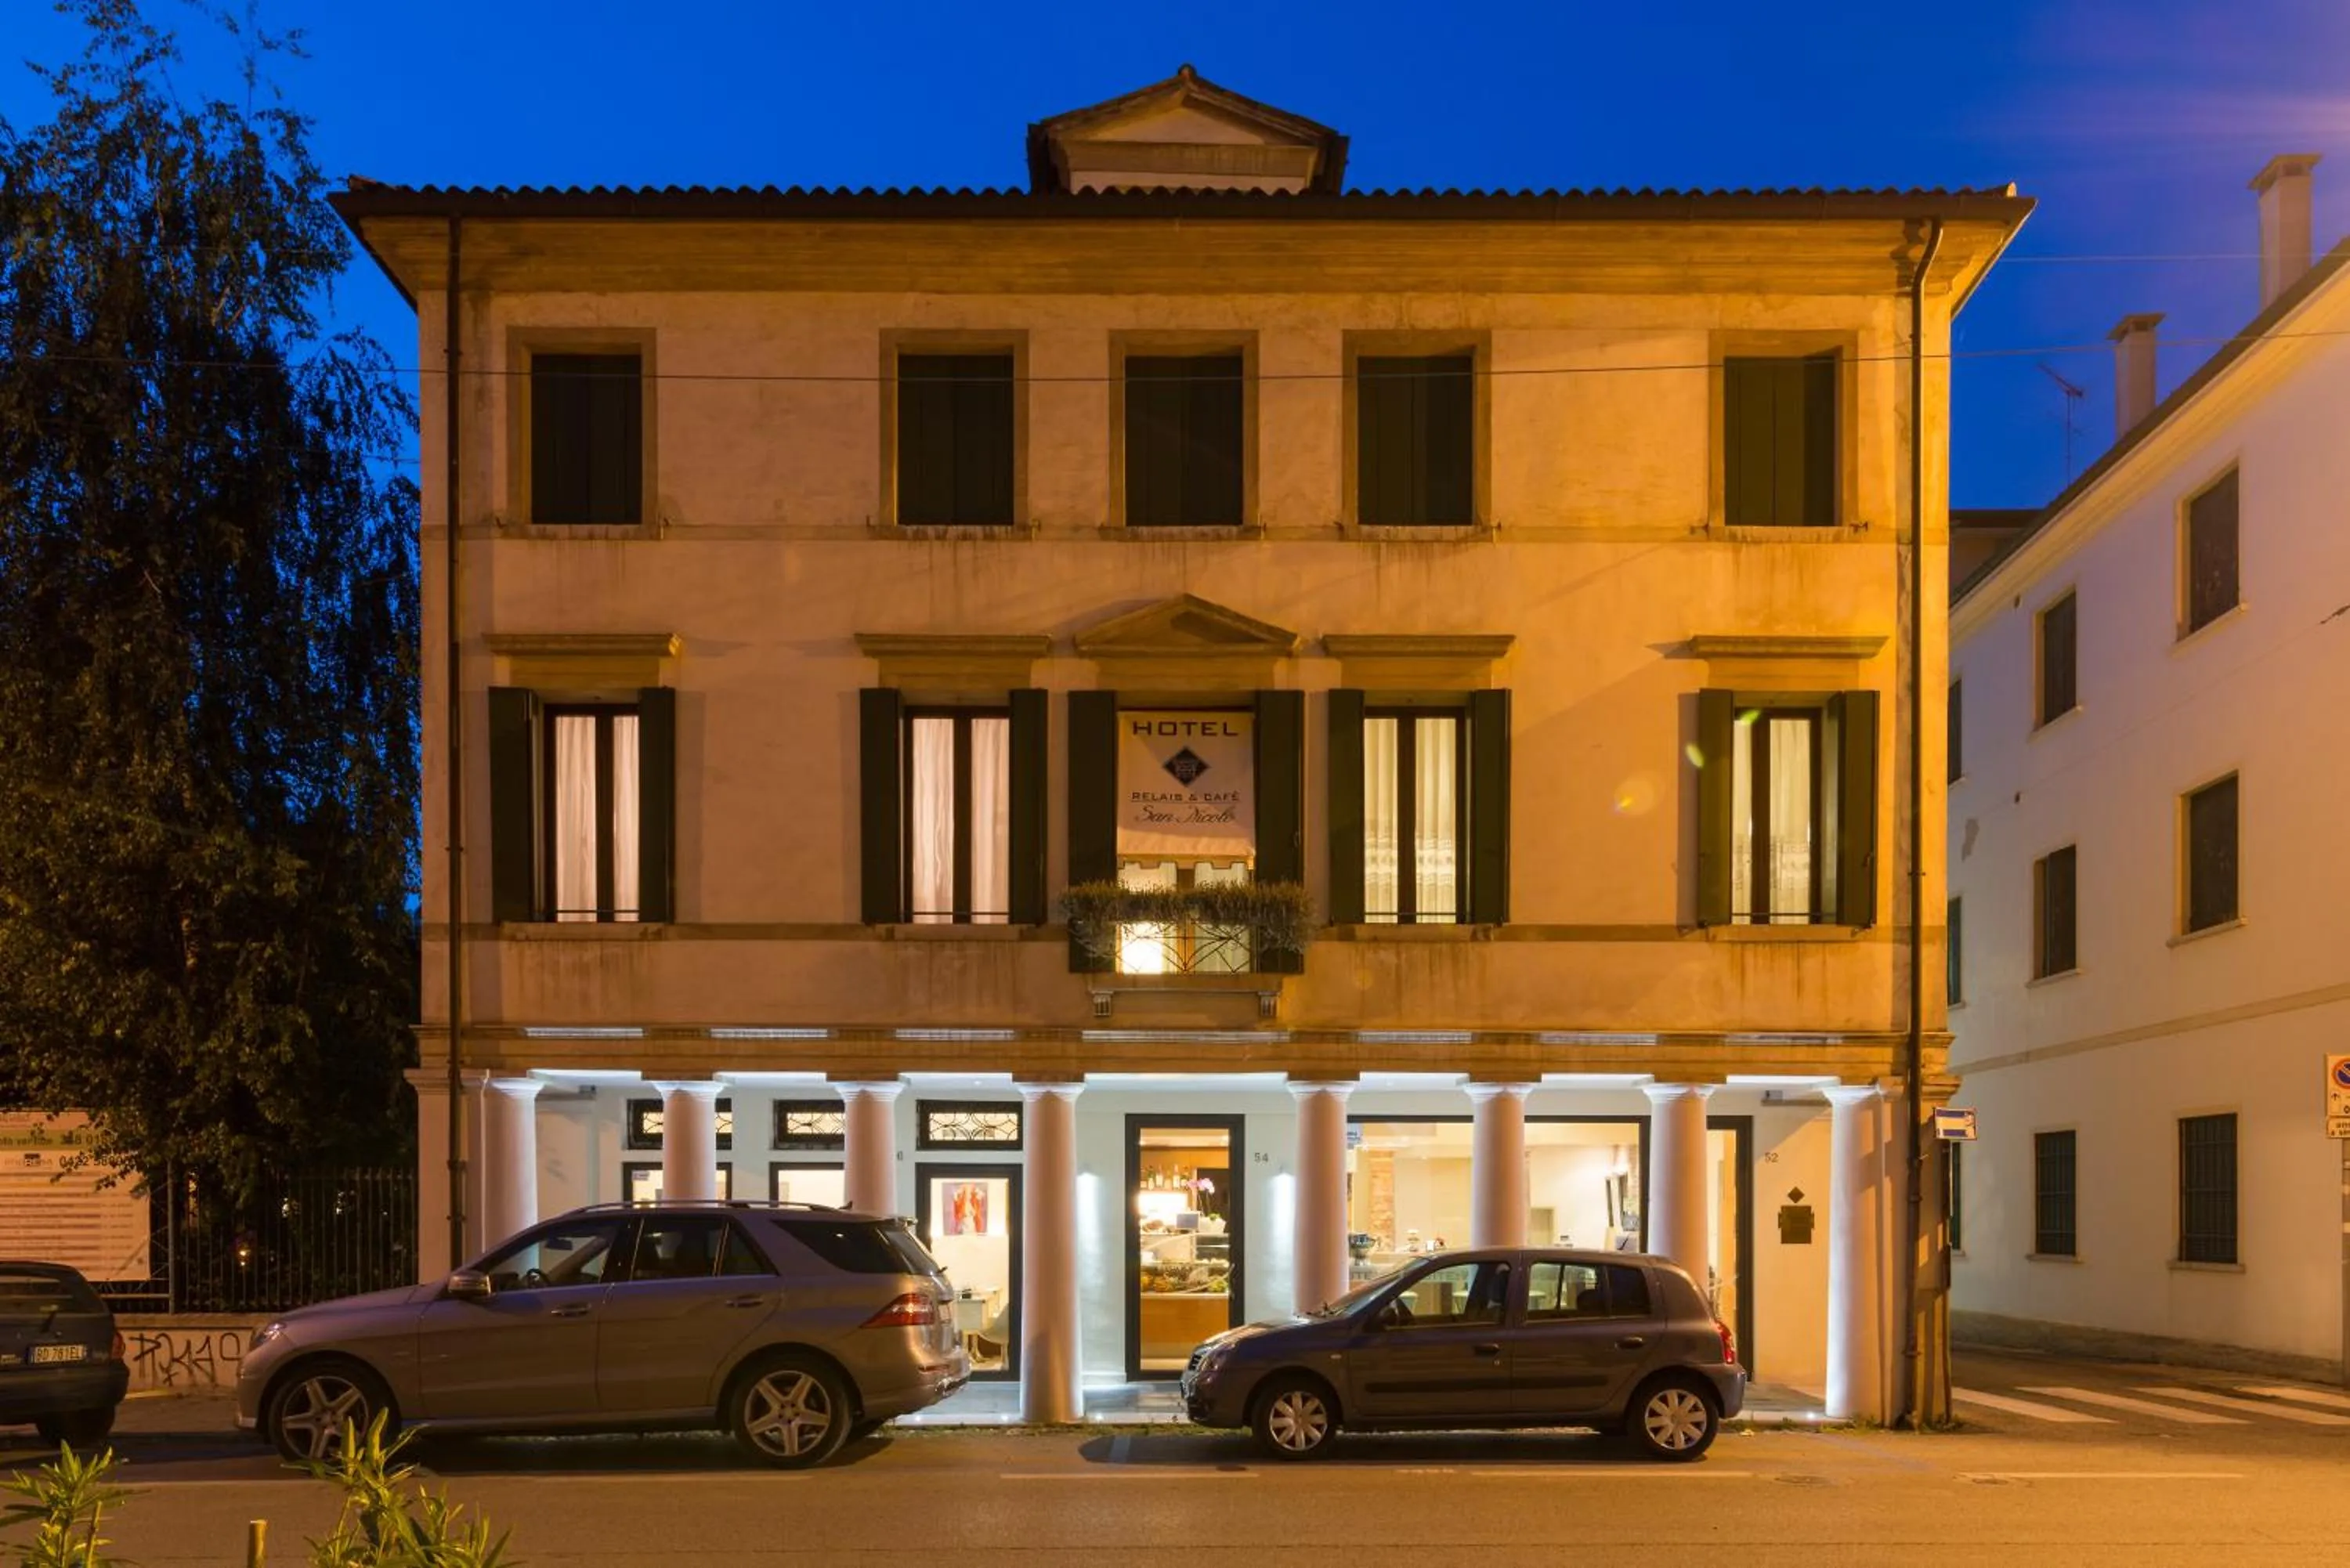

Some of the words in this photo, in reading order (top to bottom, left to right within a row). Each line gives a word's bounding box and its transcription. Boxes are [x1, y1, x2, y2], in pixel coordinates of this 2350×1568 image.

[1133, 721, 1239, 736] HOTEL
[1131, 792, 1183, 801] RELAIS
[1189, 793, 1198, 801] &
[1204, 789, 1240, 801] CAFÉ
[1254, 1152, 1268, 1163] 54
[1765, 1152, 1779, 1163] 52
